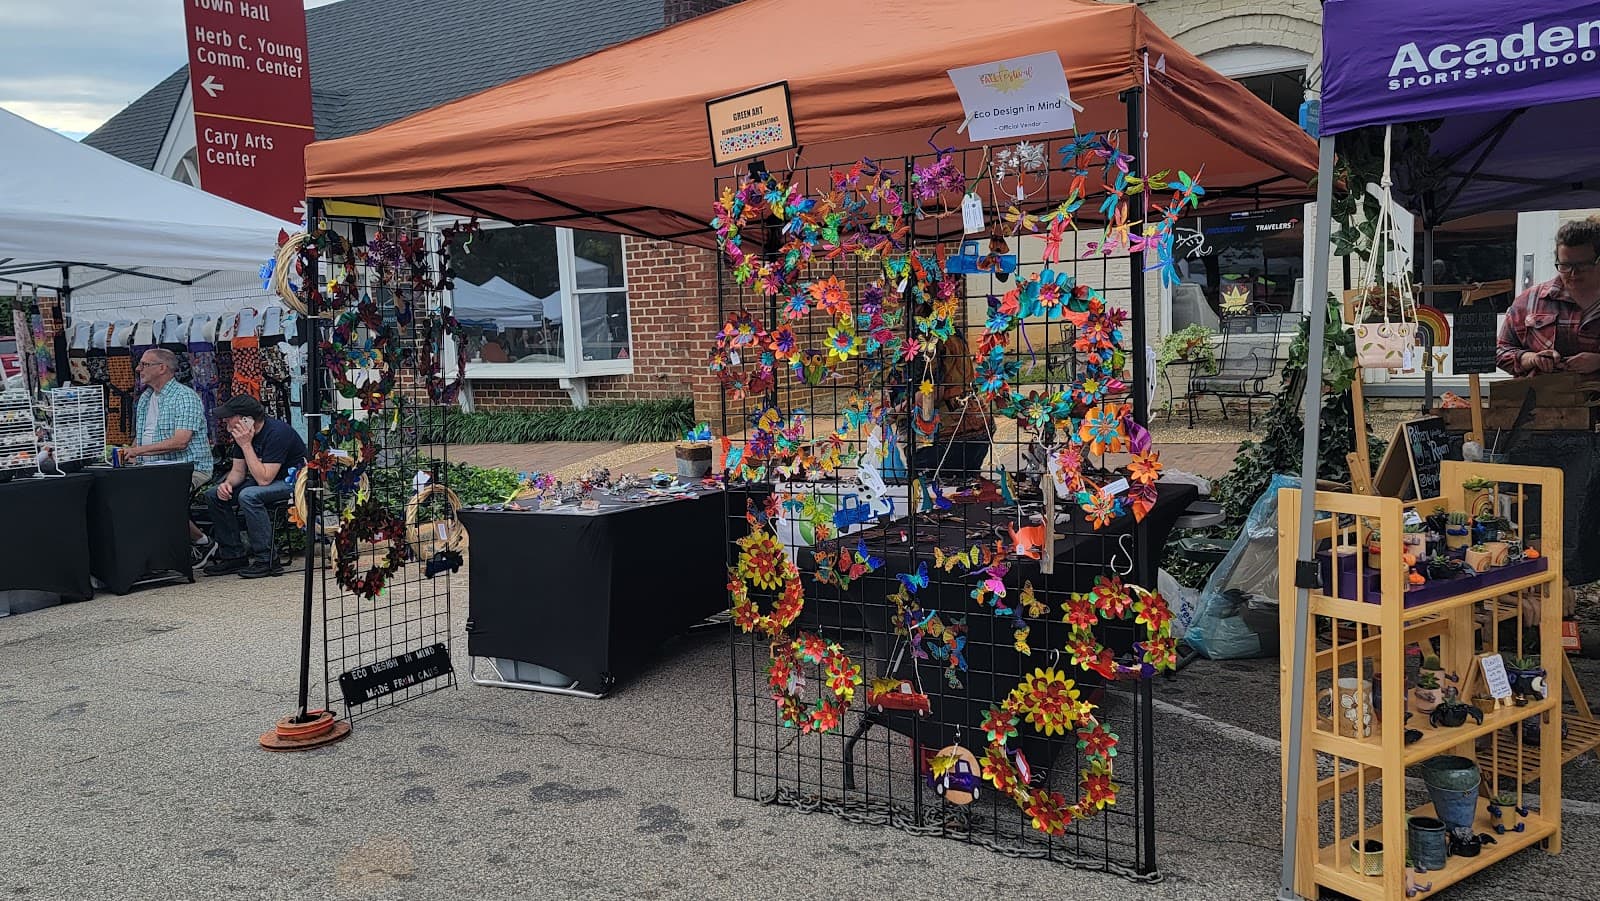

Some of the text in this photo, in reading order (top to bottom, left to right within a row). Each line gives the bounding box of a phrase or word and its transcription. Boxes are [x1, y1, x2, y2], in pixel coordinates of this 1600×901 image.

[240, 1, 270, 22] Hall
[195, 26, 302, 63] Herb C. Young
[197, 47, 303, 78] Comm. Center
[733, 106, 763, 121] GREEN ART
[974, 99, 1061, 119] Eco Design in Mind
[205, 128, 274, 150] Cary Arts
[206, 148, 257, 167] Center
[1256, 222, 1291, 232] TRAVELERS
[351, 647, 435, 680] ECO DESIGN IN MIND
[365, 682, 390, 699] MADE
